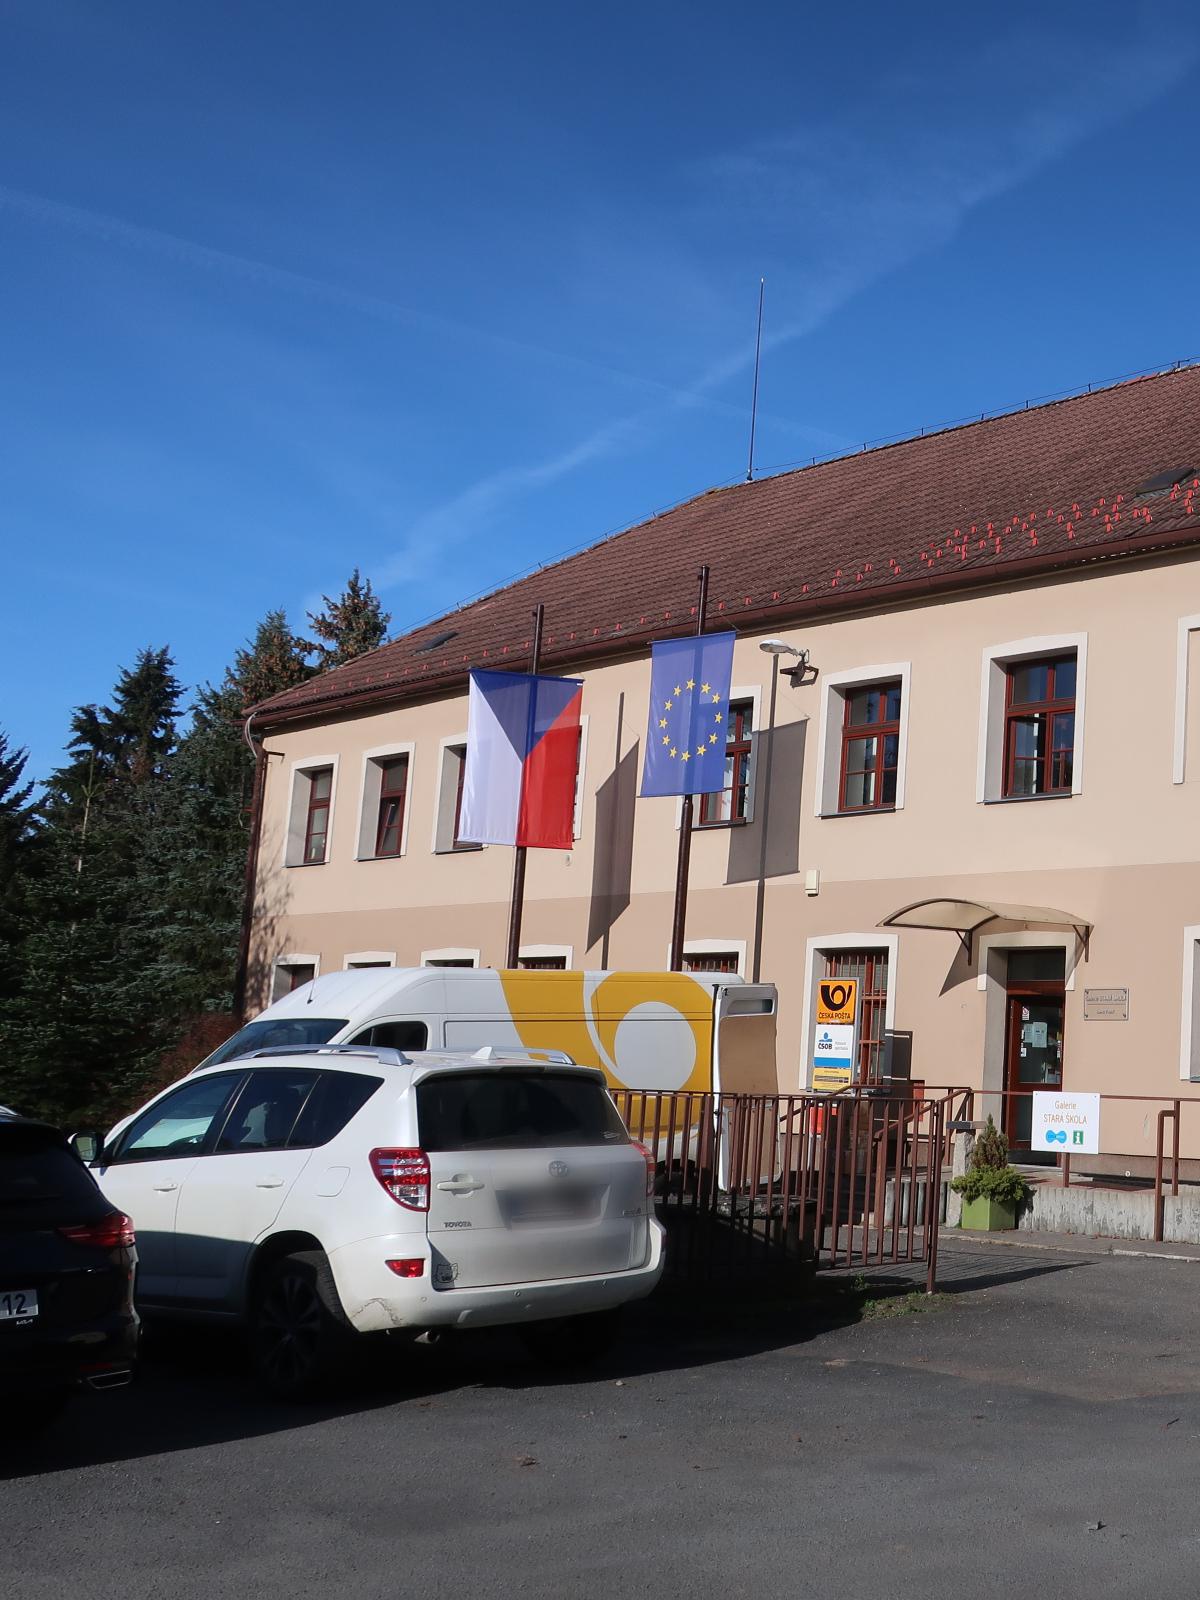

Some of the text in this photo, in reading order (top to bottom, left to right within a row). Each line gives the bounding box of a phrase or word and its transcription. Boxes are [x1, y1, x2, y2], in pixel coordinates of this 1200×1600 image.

[835, 1012, 851, 1020] POŠTA
[1054, 1100, 1077, 1110] Galerie
[443, 1220, 472, 1228] TOYOTA
[2, 1293, 28, 1316] 12
